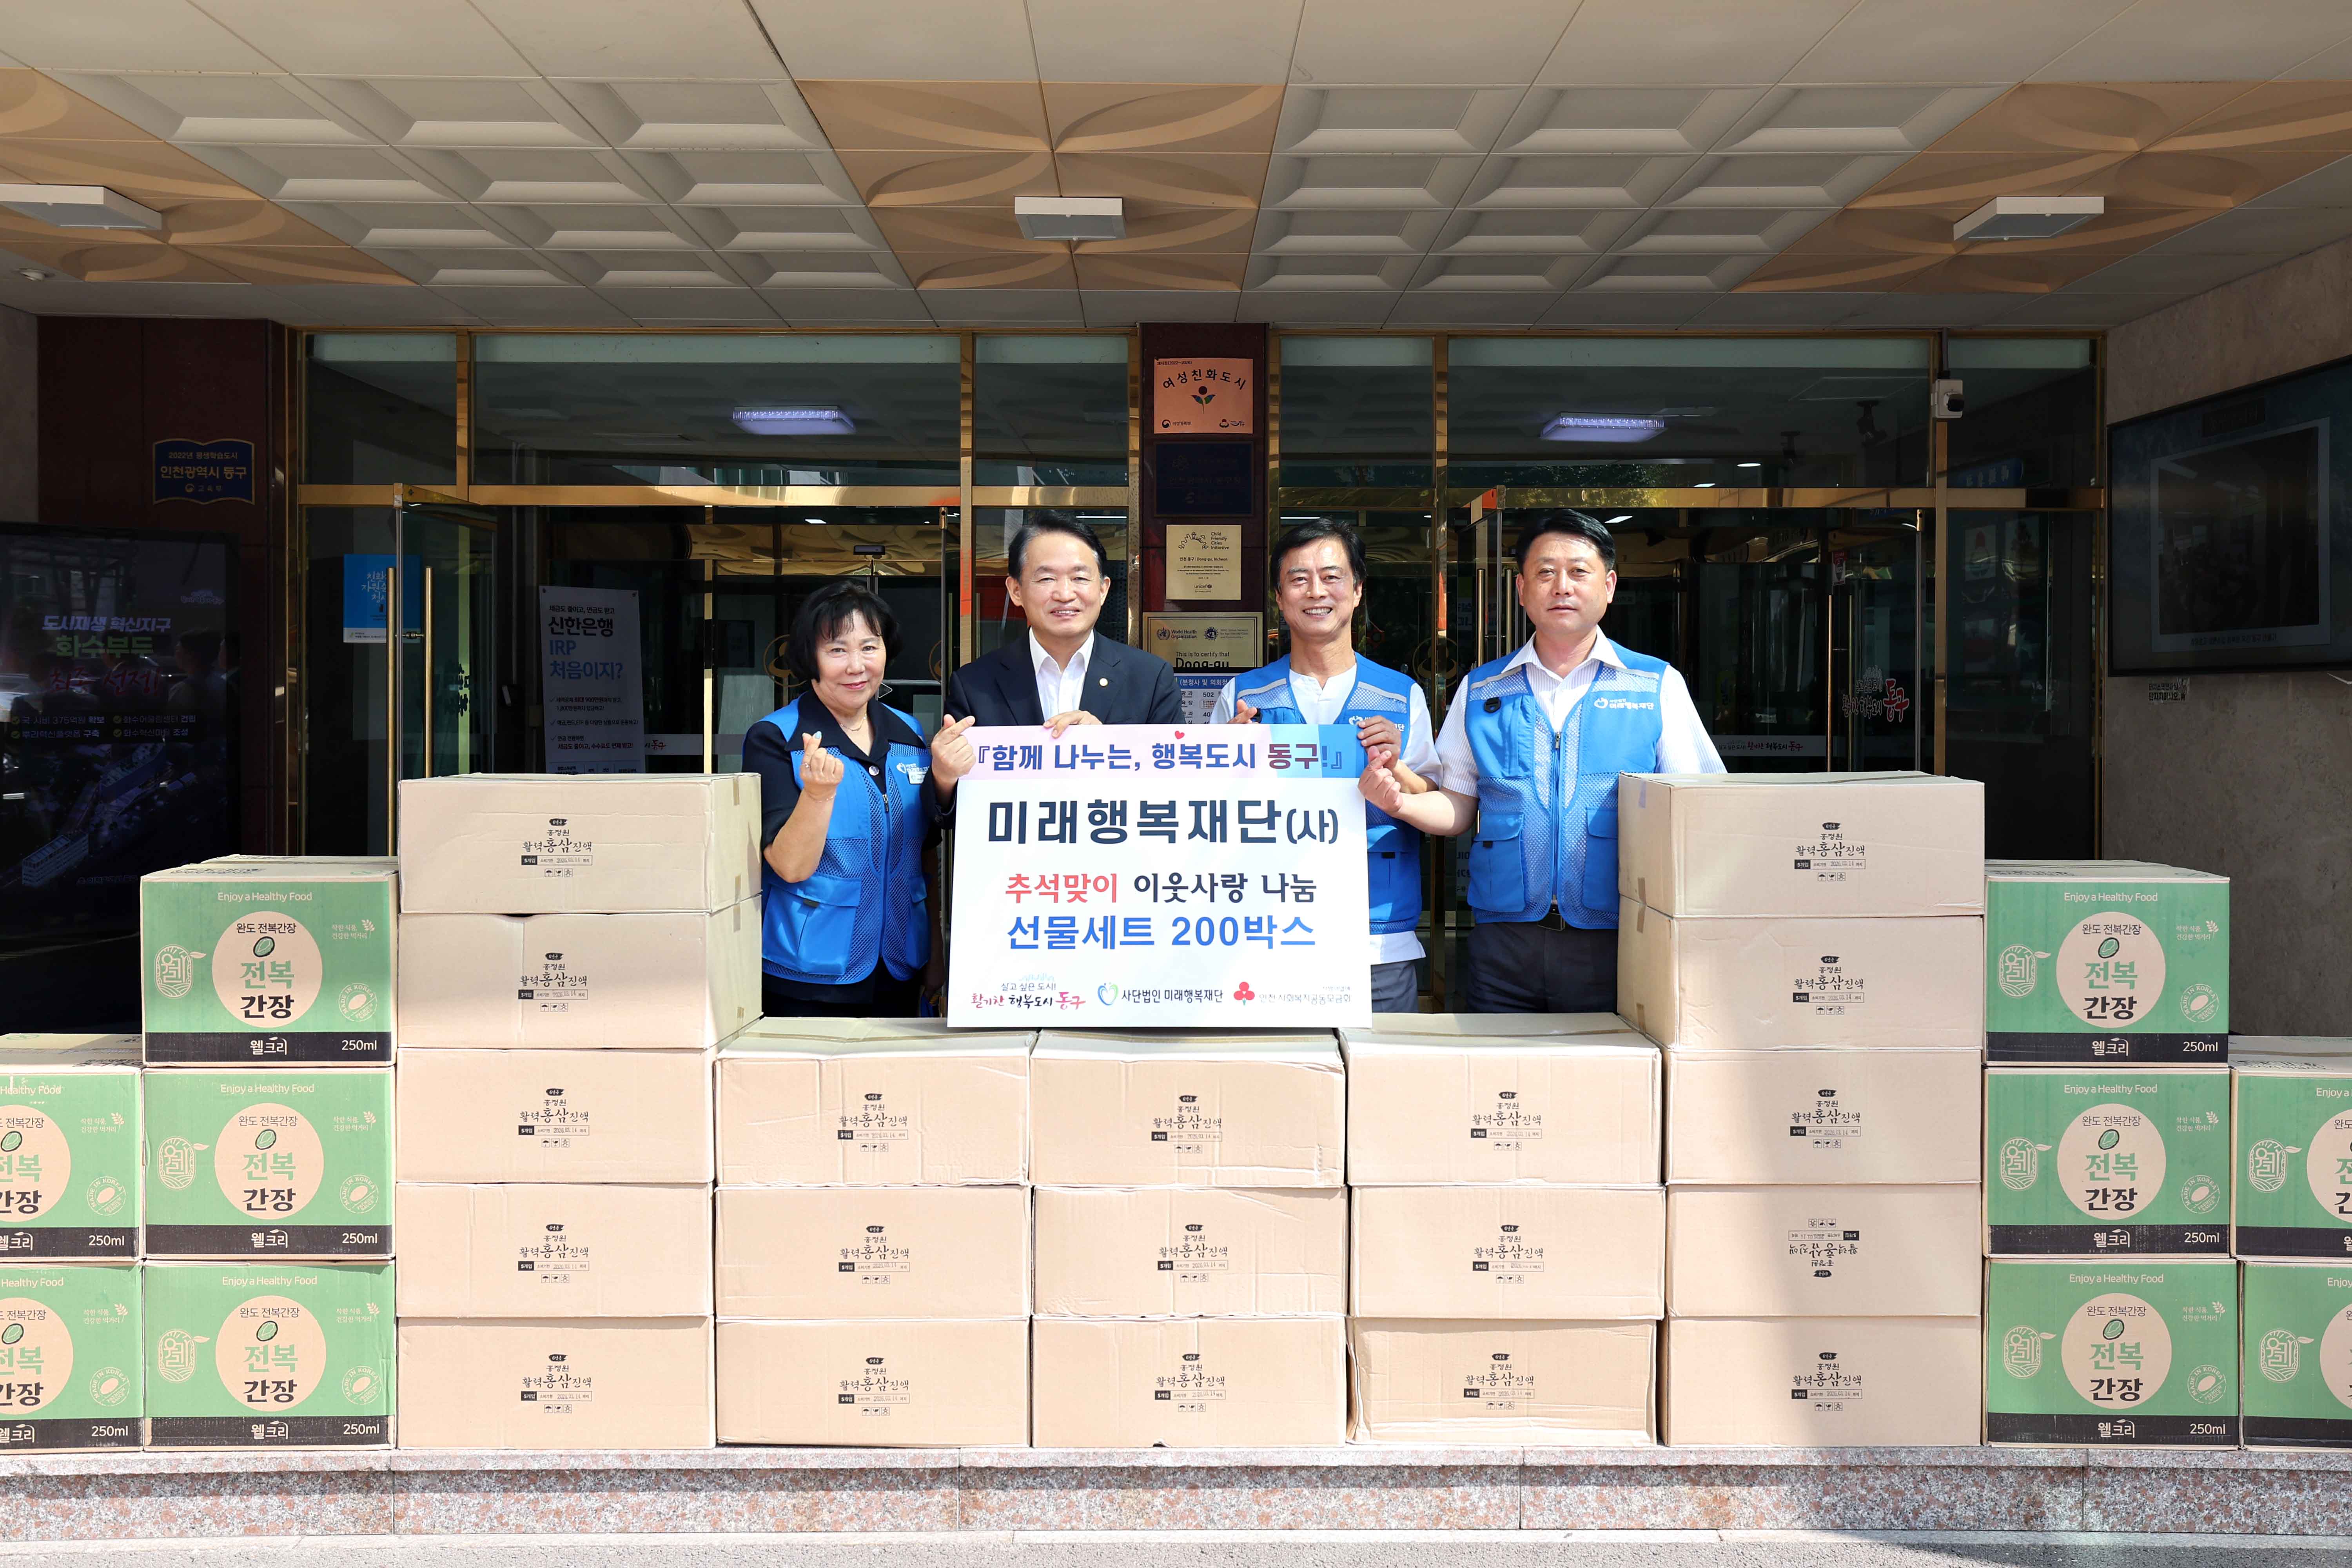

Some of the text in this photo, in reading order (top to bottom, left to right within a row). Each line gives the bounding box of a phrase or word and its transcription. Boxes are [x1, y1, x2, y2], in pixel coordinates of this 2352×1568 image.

[1163, 369, 1246, 390] 여성친화도시
[160, 466, 247, 480] 인천광역시 동구
[42, 615, 171, 632] 도시재생 혁신지구
[548, 617, 613, 637] 신한은행
[56, 635, 153, 658] 화수부두
[550, 639, 576, 655] IRP
[550, 661, 623, 680] 처음이지?
[1883, 678, 1909, 723] 동구
[1789, 741, 1803, 751] 동구
[1054, 744, 1141, 771] 나누는,
[1152, 743, 1256, 769] 행복도시
[988, 799, 1339, 844] 미래행복재단(사)
[523, 837, 592, 853] 활력홍삼진액
[1796, 841, 1865, 857] 활력홍삼진액
[1005, 872, 1317, 904] 추석맞이 이웃사랑 나눔
[218, 892, 244, 902] Enjoy
[252, 892, 287, 902] Healthy
[290, 892, 312, 900] Food
[236, 923, 296, 934] 완도 전복간장
[1007, 915, 1316, 950] 선물세트 200박스
[240, 960, 295, 989] 전복
[519, 972, 587, 987] 활력홍삼진액
[1794, 975, 1864, 990] 활력홍삼진액
[971, 991, 1086, 1010] 활기찬 행복도시 동구
[1122, 989, 1223, 1006] 사단법인 미래행복재단
[1259, 993, 1351, 1005] 인천 사회복지공동모금회
[240, 994, 294, 1018] 간장
[250, 1037, 287, 1055] 웰크리
[342, 1040, 377, 1051] 250ml
[2092, 1038, 2128, 1056] 웰크리
[2183, 1042, 2218, 1053] 250ml
[2064, 1085, 2090, 1094] Enjoy
[2098, 1085, 2133, 1094] Healthy
[2136, 1085, 2158, 1093] Food
[2316, 1088, 2343, 1098] Enjoy
[519, 1107, 589, 1123] 활력홍삼진액
[838, 1112, 907, 1127] 활력홍삼진액
[2082, 1116, 2141, 1127] 완도 전복간장
[243, 1152, 296, 1180] 전복
[2085, 1153, 2139, 1181] 전복
[243, 1187, 296, 1211] 간장
[2084, 1187, 2138, 1211] 간장
[89, 1235, 124, 1246] 250ml
[251, 1229, 287, 1248] 웰크리
[343, 1233, 377, 1244] 250ml
[2094, 1229, 2130, 1247] 웰크리
[2185, 1232, 2220, 1243] 250ml
[1158, 1243, 1228, 1258] 활력홍삼진액
[1474, 1243, 1543, 1259] 활력홍삼진액
[1789, 1243, 1858, 1258] 활력홍삼진액
[2090, 1342, 2143, 1370] 전복
[840, 1376, 909, 1392] 활력홍삼진액
[1156, 1372, 1225, 1388] 활력홍삼진액
[2089, 1377, 2143, 1401] 간장
[91, 1426, 128, 1437] 250ml
[251, 1421, 288, 1439] 웰크리
[343, 1424, 379, 1435] 250ml
[2098, 1419, 2134, 1438] 웰크리
[2190, 1424, 2226, 1435] 250ml
